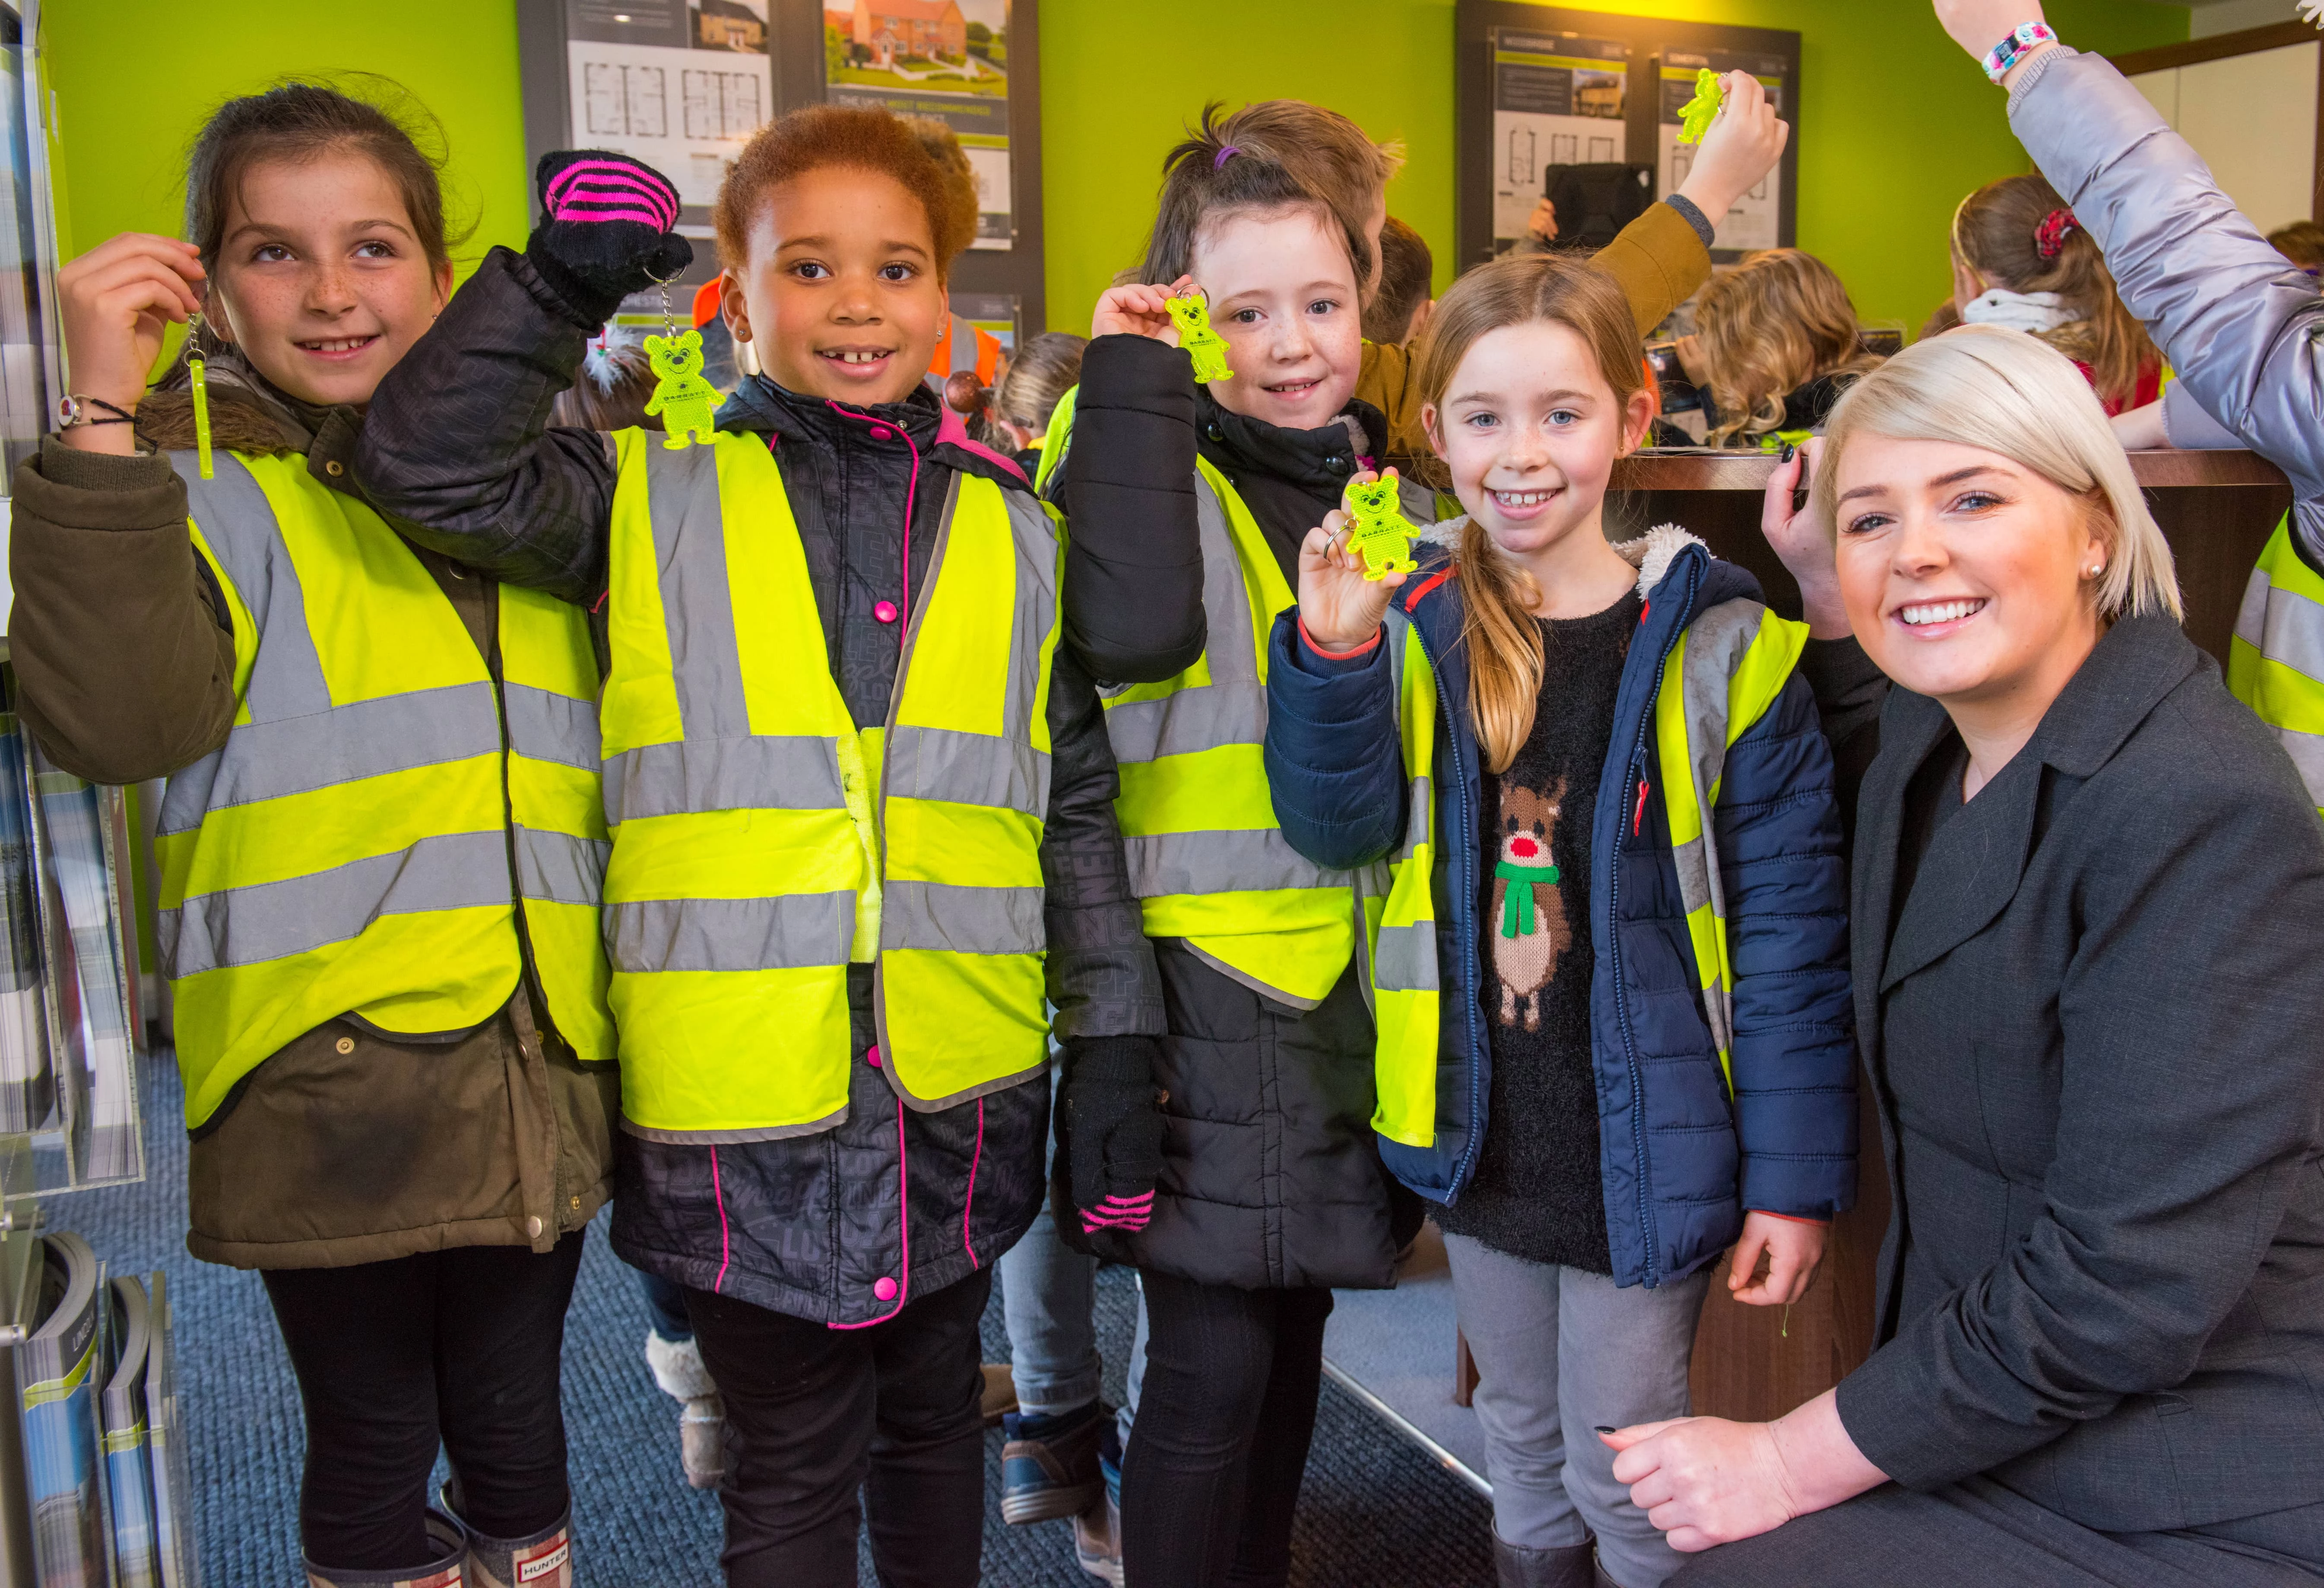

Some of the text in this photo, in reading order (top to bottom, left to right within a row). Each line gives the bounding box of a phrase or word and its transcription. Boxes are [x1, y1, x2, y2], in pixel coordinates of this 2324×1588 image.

[664, 391, 705, 401] BARRATT
[1362, 525, 1399, 538] BARRATT
[524, 1549, 567, 1575] HUNTER
